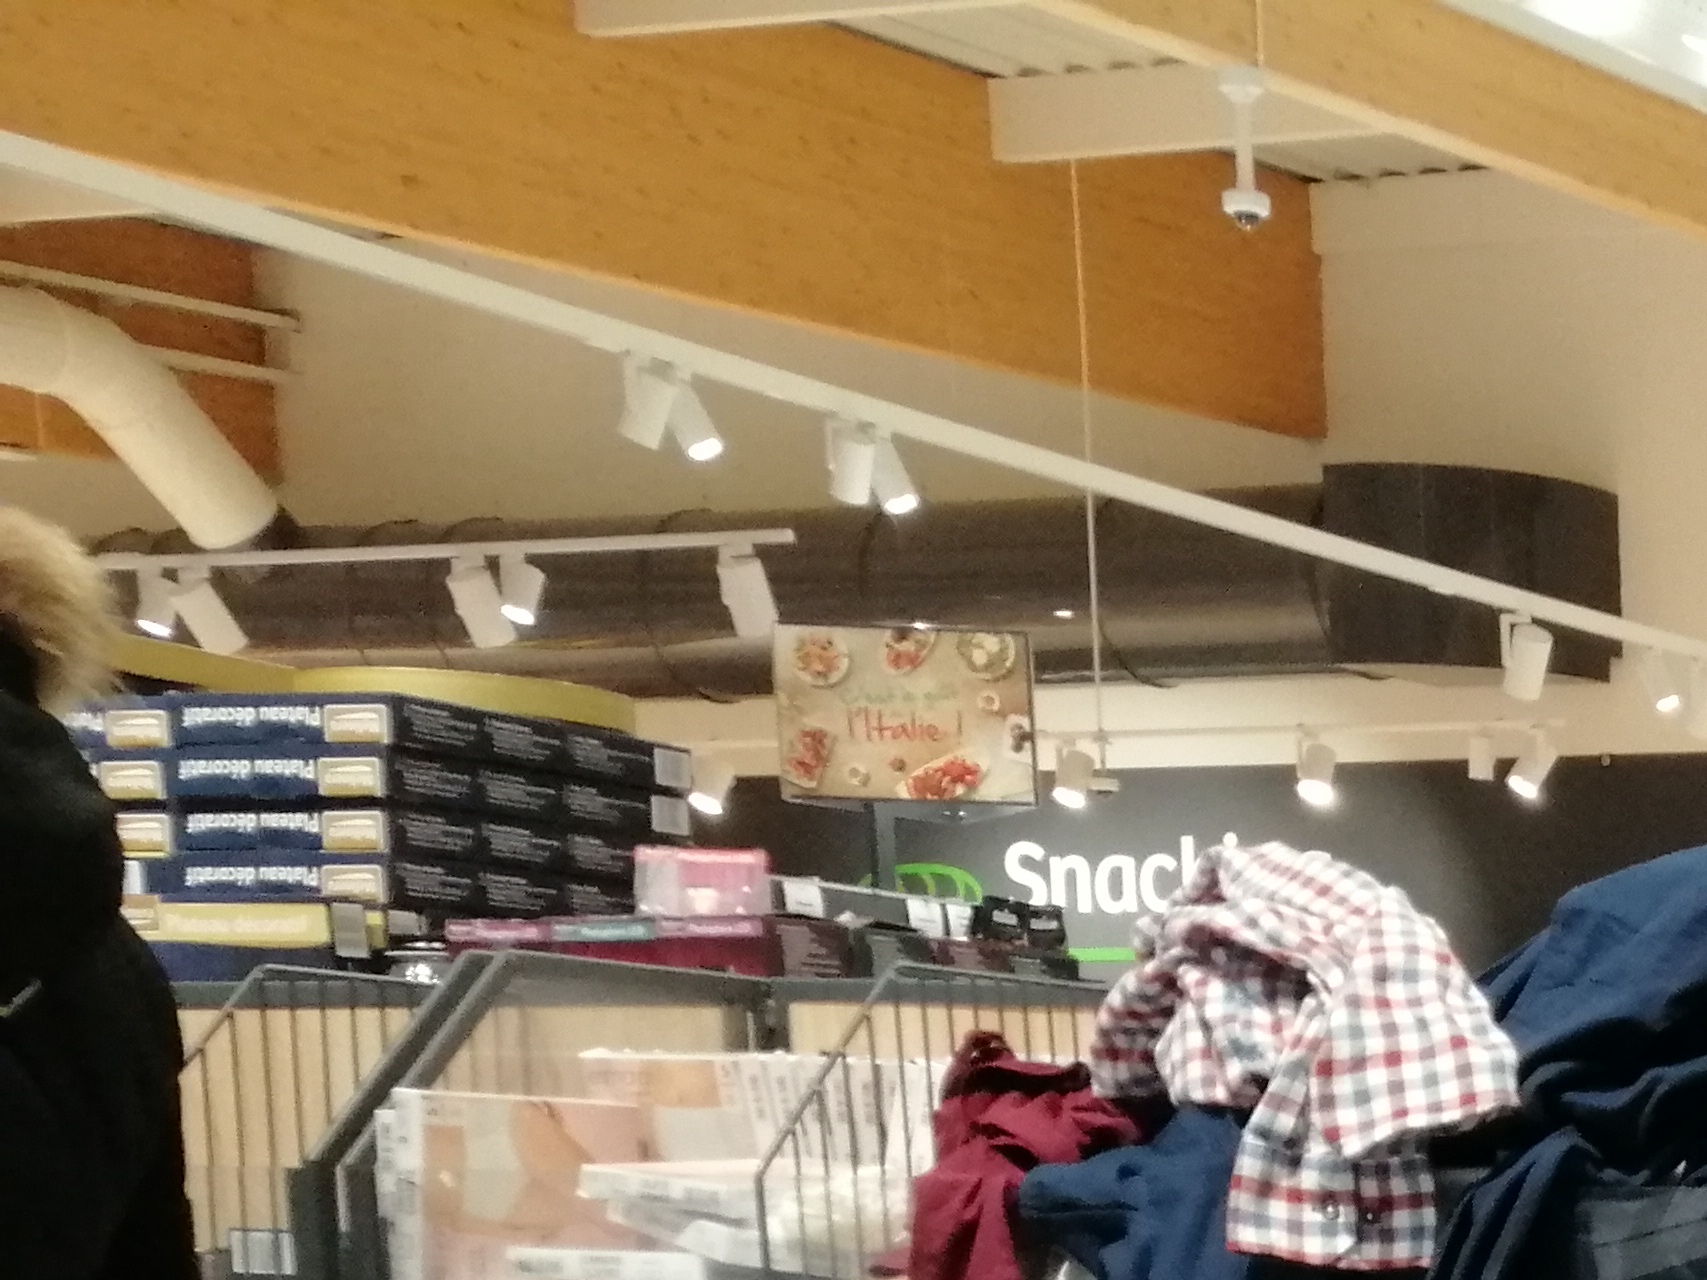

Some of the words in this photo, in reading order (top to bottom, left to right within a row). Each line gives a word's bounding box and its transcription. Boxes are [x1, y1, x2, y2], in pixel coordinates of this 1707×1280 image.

[260, 706, 321, 727] Plateau
[254, 759, 315, 780] Plateau
[260, 812, 320, 834] Plateau
[259, 866, 319, 887] Plateau
